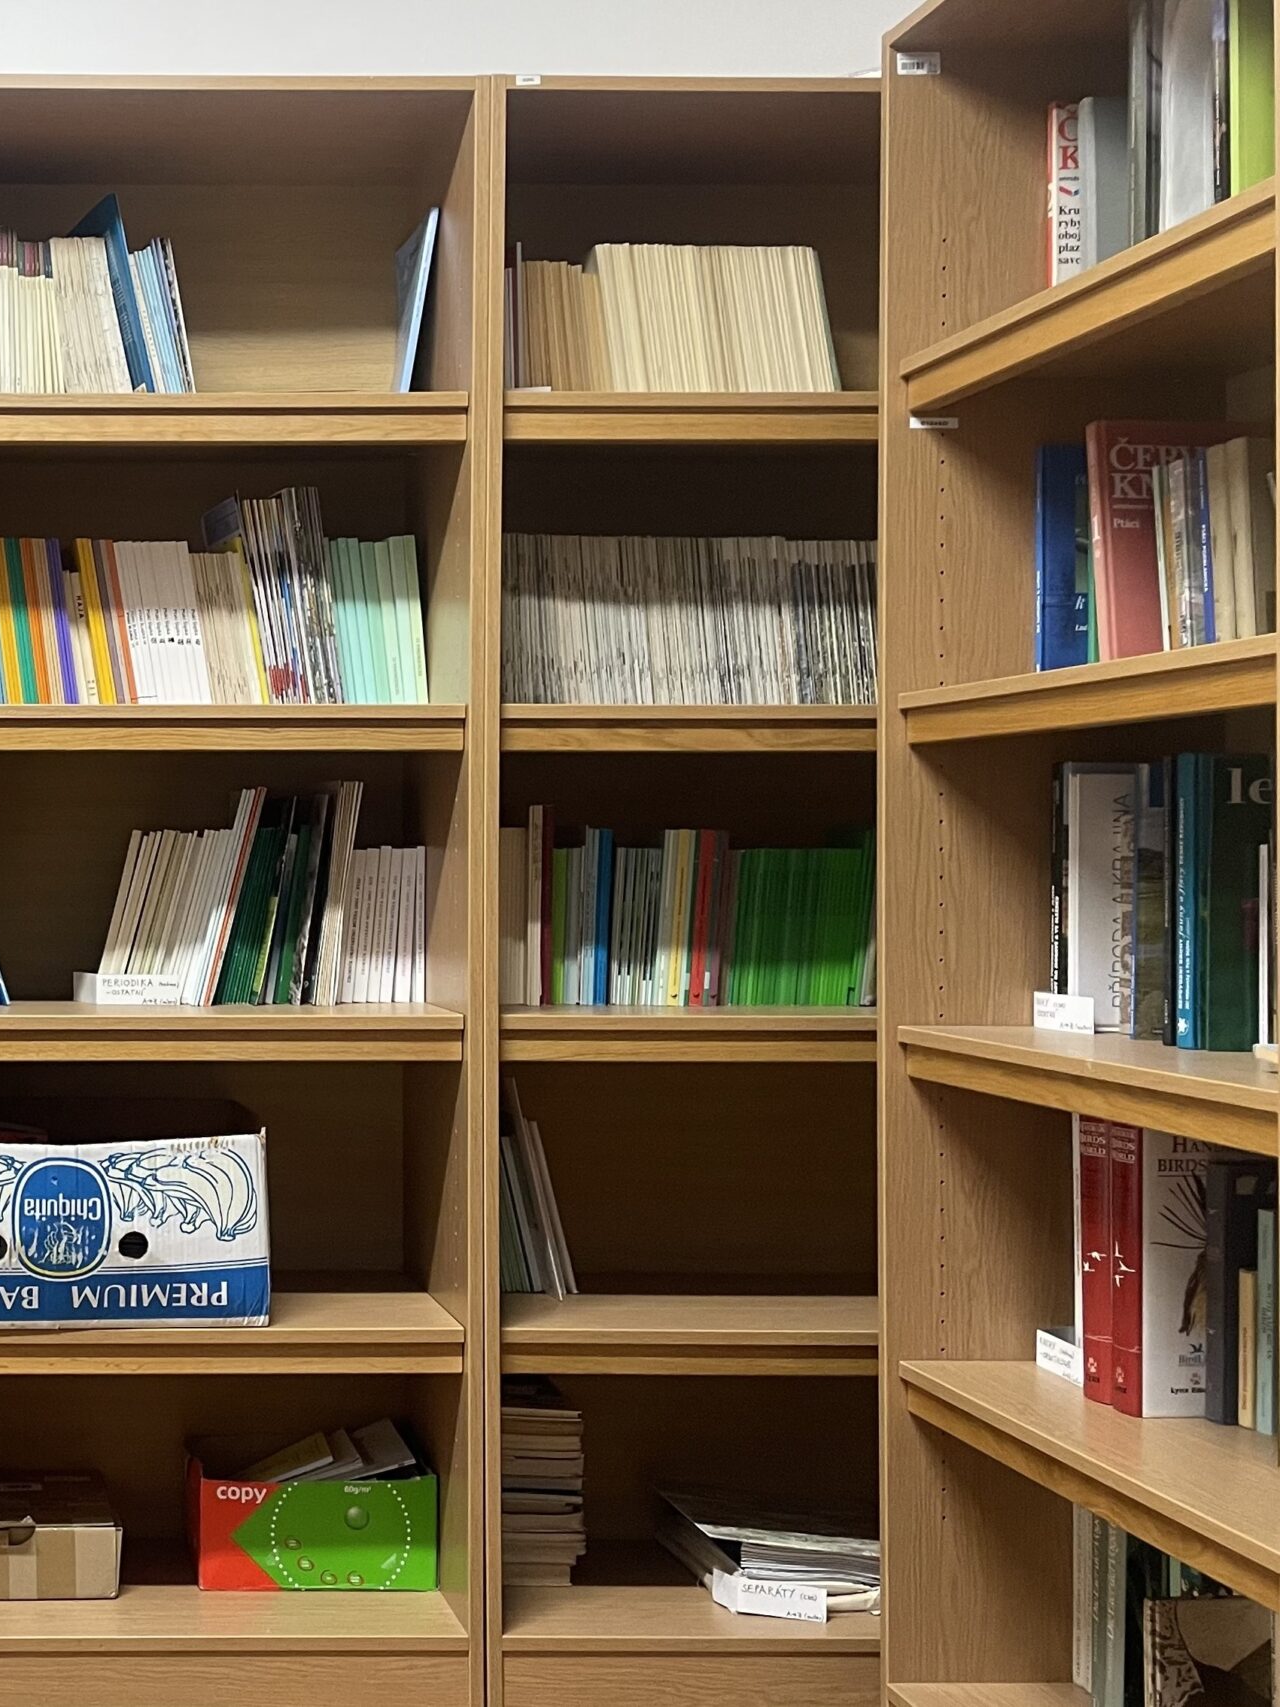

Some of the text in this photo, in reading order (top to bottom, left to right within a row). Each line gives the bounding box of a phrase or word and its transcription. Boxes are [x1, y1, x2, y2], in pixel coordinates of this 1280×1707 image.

[102, 977, 154, 988] PERIODIKA
[1157, 1158, 1207, 1172] BIRDS
[23, 1193, 102, 1222] Chiquita
[72, 1279, 228, 1309] PREMIUM
[216, 1484, 268, 1504] copy
[741, 1583, 796, 1600] SEPARÁTY
